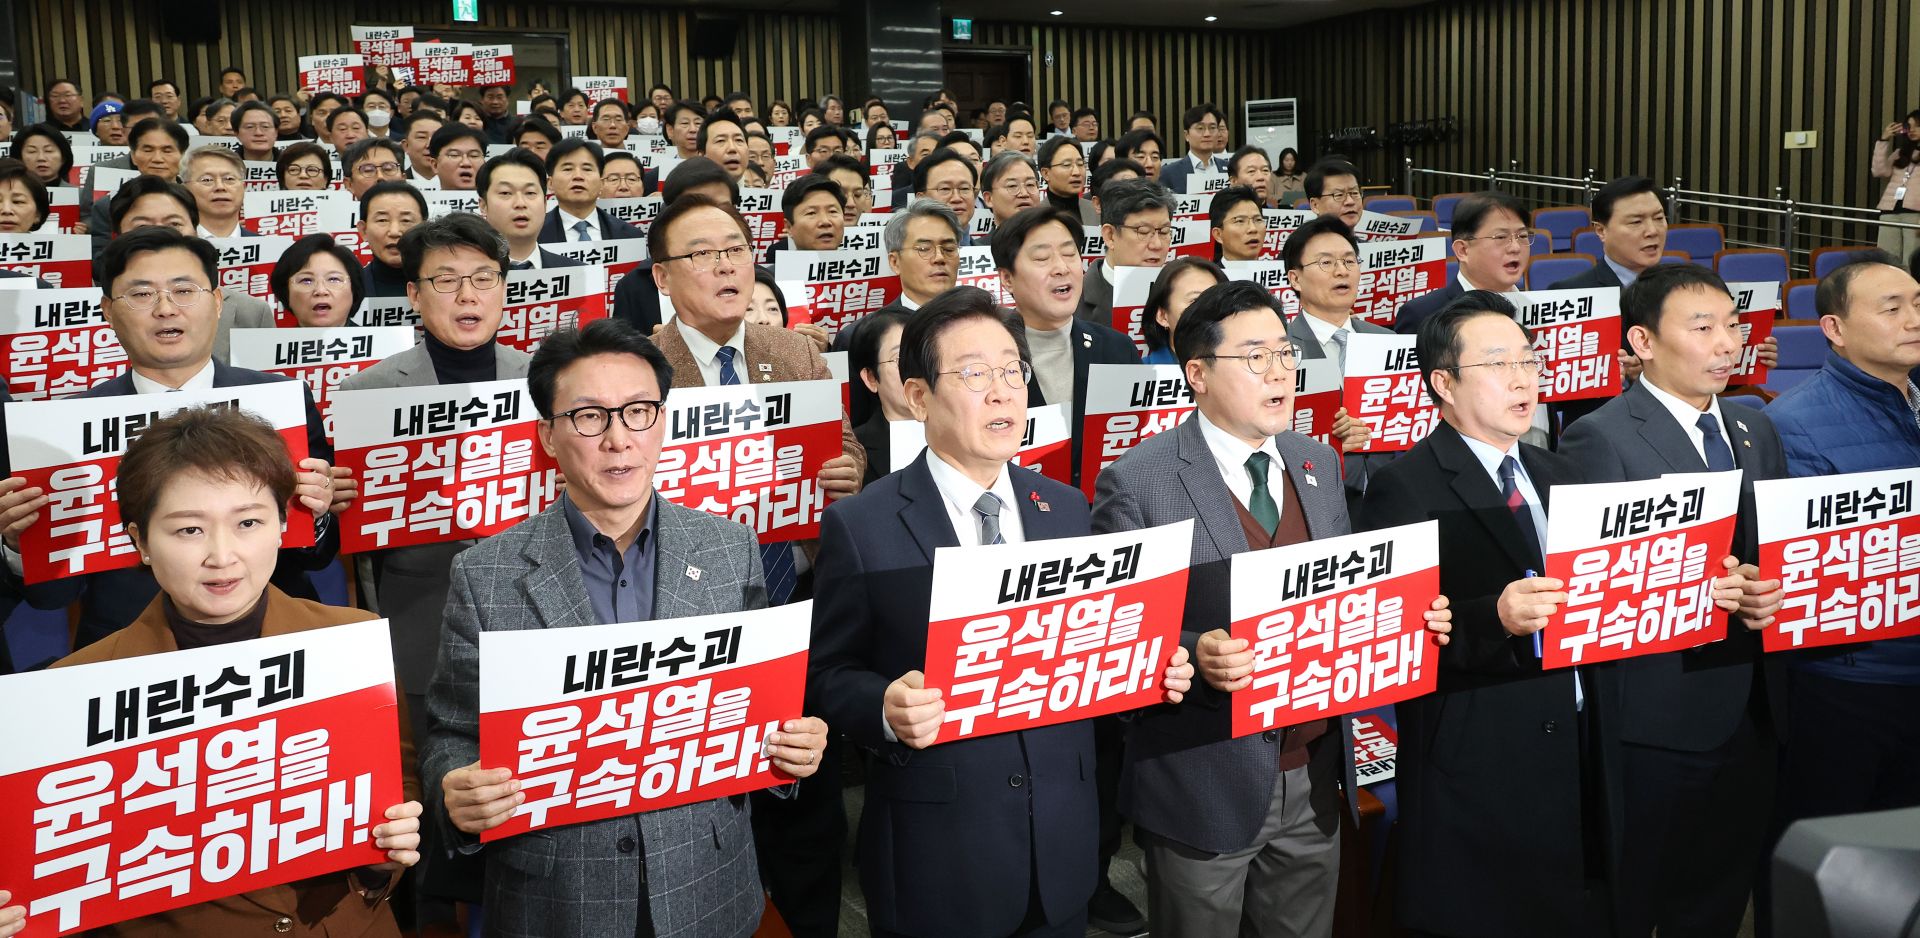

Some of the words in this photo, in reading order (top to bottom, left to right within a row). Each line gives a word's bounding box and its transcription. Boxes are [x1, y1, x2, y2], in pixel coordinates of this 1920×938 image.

[365, 29, 399, 40] 내란수괴
[424, 46, 458, 57] 내란수괴
[313, 57, 348, 69] 내란수괴
[419, 69, 469, 84] 구속하라!
[473, 58, 503, 72] 석열을
[473, 69, 510, 84] 속하라!
[585, 79, 616, 89] 내란수괴
[1366, 219, 1410, 234] 내란수괴
[808, 257, 880, 281] 내란수괴
[958, 253, 997, 274] 란수
[1369, 245, 1424, 269] 내란수괴
[506, 275, 570, 304] 란수괴
[1522, 296, 1593, 325] 내란수괴
[497, 304, 579, 341] 석열을
[1533, 324, 1600, 362] 석열을
[275, 335, 373, 365] 내란수괴
[393, 390, 521, 437] 내란수괴
[672, 393, 791, 440] 내란수괴
[363, 431, 532, 497] 윤석열을
[1600, 487, 1705, 539] 내란수괴
[1806, 480, 1913, 530] 내란수괴
[997, 543, 1143, 604] 내란수괴
[1282, 541, 1394, 602] 내란수괴
[1567, 533, 1708, 607] 윤석열을
[954, 593, 1145, 678] 윤석열을
[1254, 588, 1403, 671] 윤석열을
[1560, 576, 1717, 662] 구속하라!
[563, 625, 743, 695] 내란수괴
[1249, 629, 1425, 728] 구속하라!
[87, 649, 305, 747] 내란수괴
[944, 636, 1163, 737] 구속하라!
[518, 678, 751, 774] 윤석열을
[33, 718, 330, 855] 윤석열을
[512, 720, 780, 828] 구속하라!
[30, 772, 372, 933] 구속하라!
